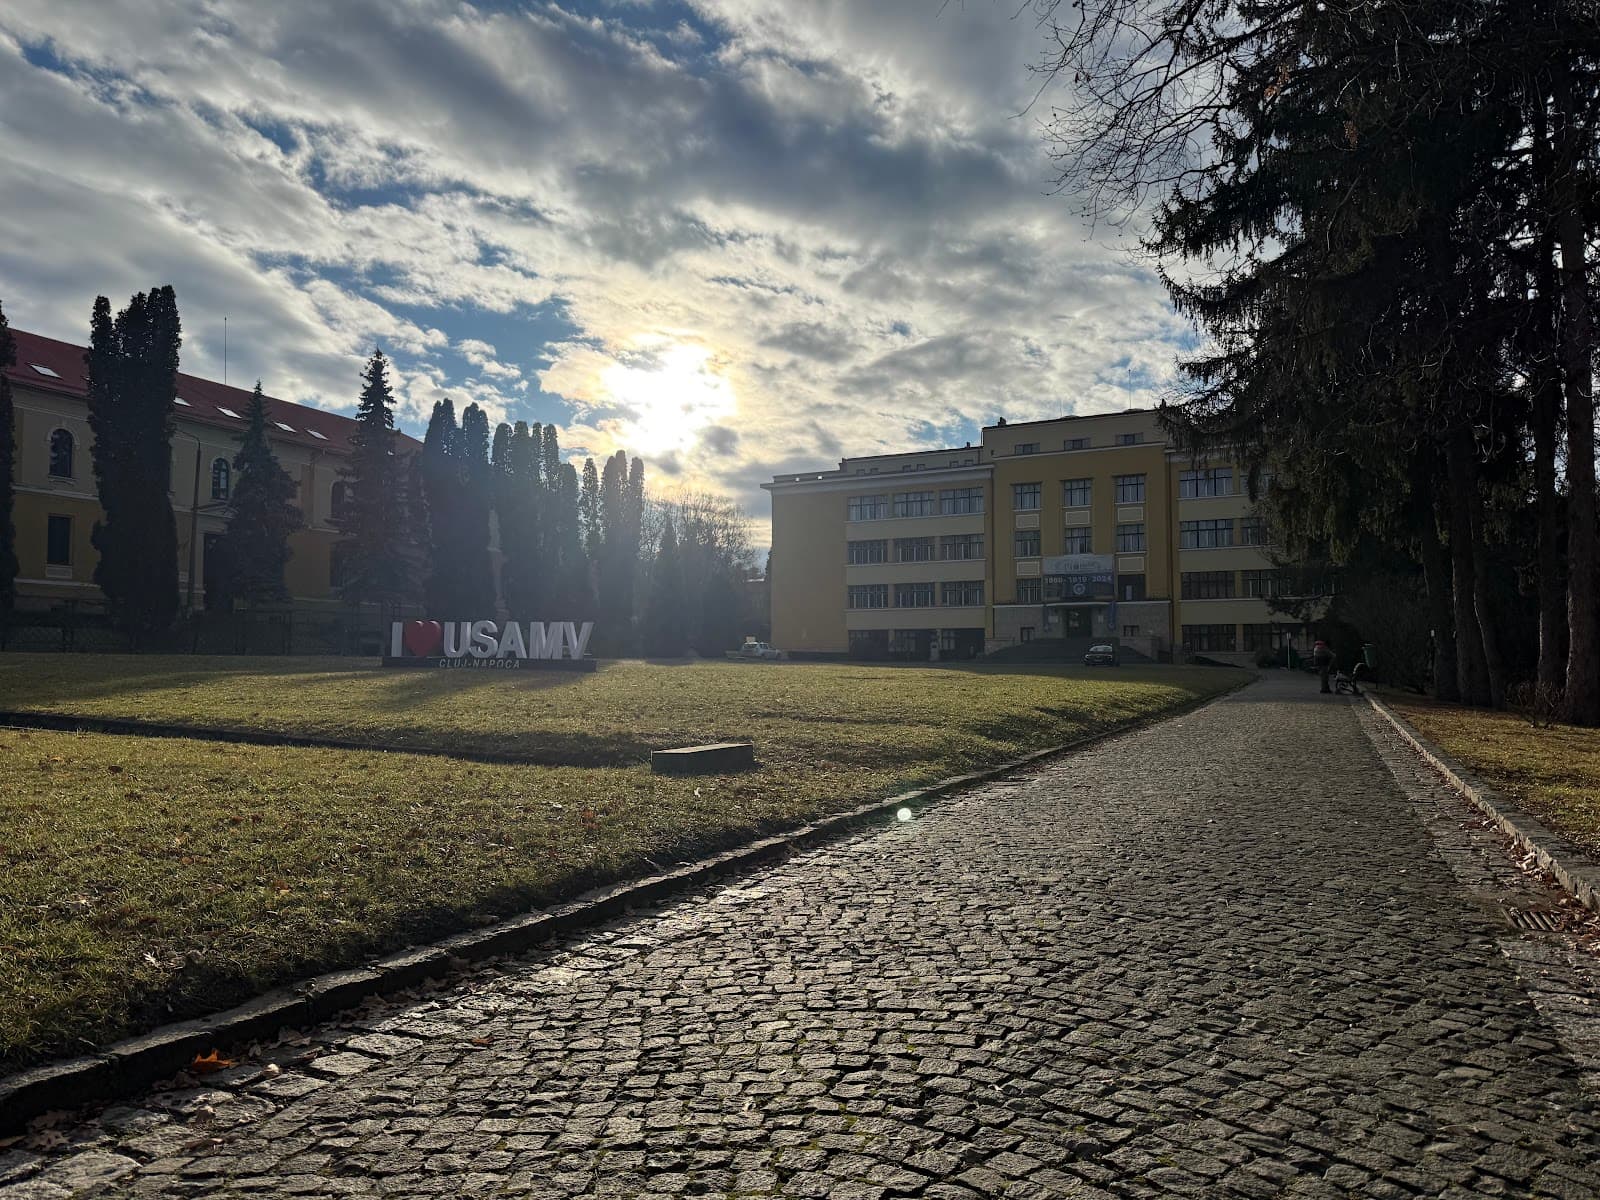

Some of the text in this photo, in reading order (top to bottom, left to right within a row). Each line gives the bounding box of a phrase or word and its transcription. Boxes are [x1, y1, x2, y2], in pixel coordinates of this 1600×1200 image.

[391, 619, 594, 659] I USAMV
[438, 657, 521, 669] CLUJ-NAPOCA
